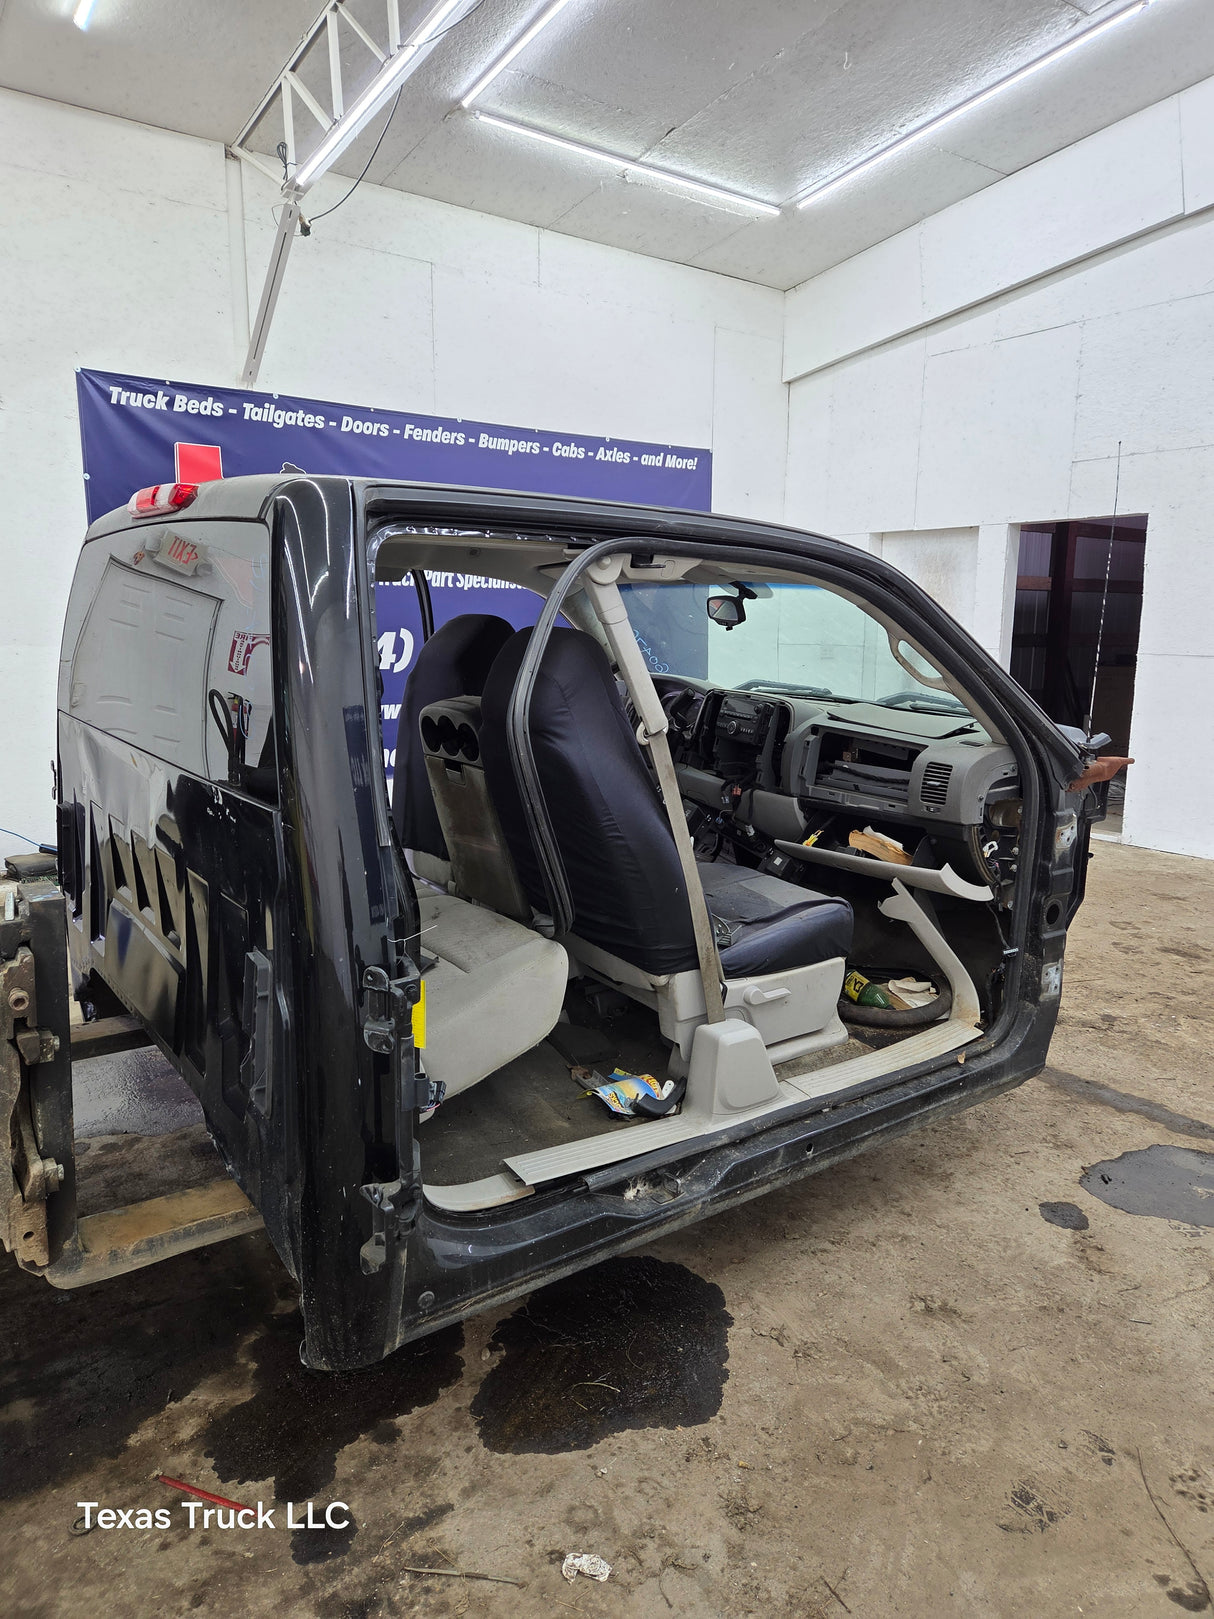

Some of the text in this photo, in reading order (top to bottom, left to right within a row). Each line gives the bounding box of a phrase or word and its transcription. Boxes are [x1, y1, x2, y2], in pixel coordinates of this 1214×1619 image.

[109, 386, 169, 410] Truck
[173, 394, 224, 417] Beds
[243, 402, 325, 429] Tailgates
[340, 415, 390, 437] Doors
[403, 424, 465, 446] Fenders
[478, 433, 540, 455] Bumpers
[552, 441, 585, 459] Cabs
[595, 446, 631, 464] Axles
[640, 452, 663, 467] and
[664, 455, 698, 470] More!
